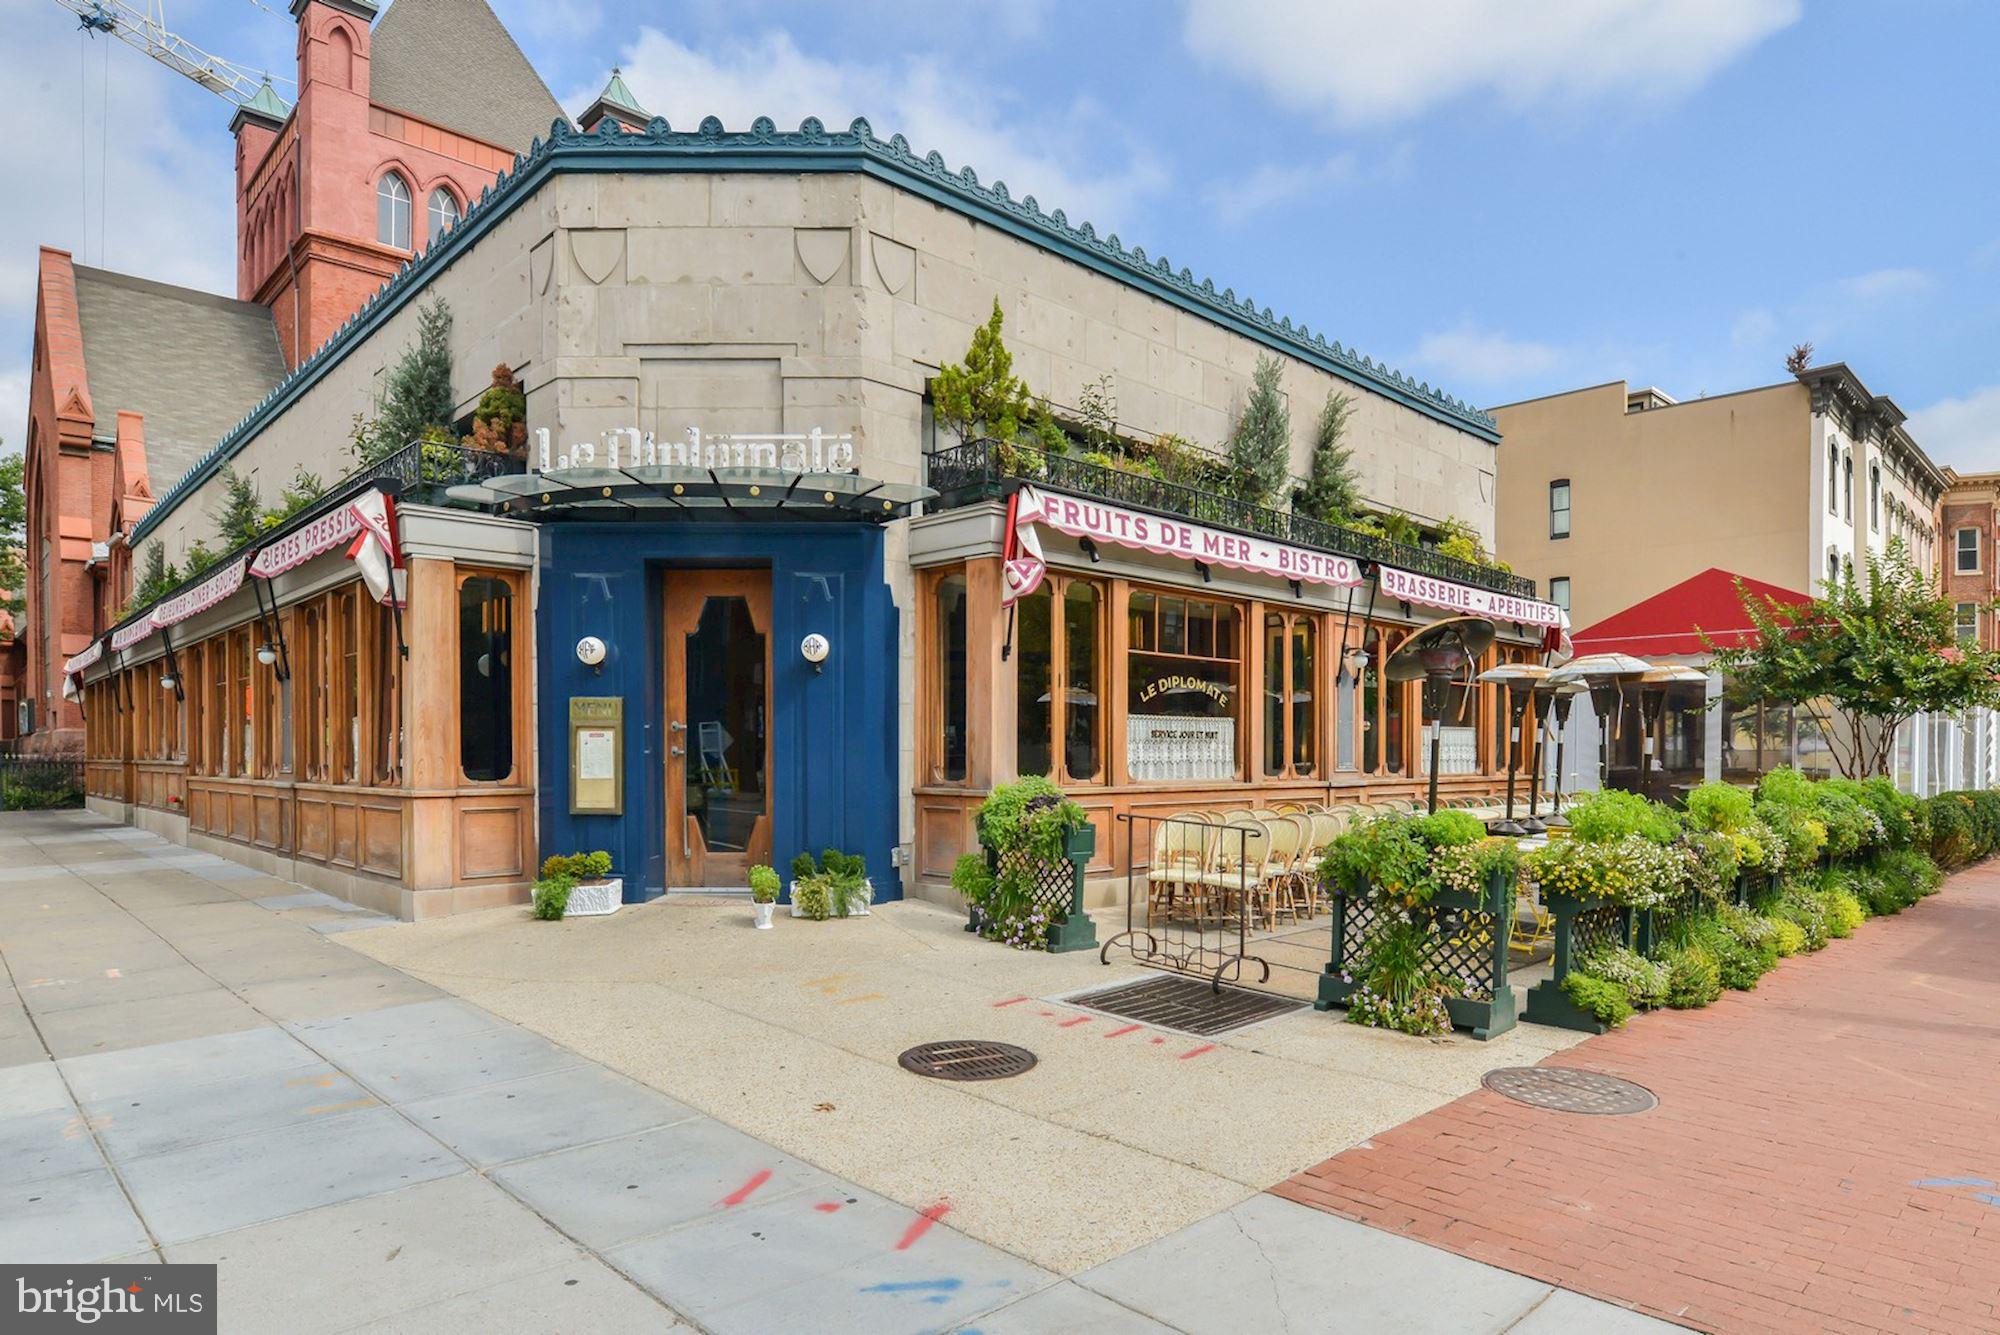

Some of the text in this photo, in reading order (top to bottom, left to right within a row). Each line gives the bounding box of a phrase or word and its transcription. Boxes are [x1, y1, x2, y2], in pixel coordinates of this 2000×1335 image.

[535, 427, 595, 473] Le
[305, 507, 358, 549] PRESSIO
[1042, 495, 1149, 541] FRUITS
[1160, 522, 1193, 550] DE
[1203, 532, 1251, 562] MER
[1278, 548, 1350, 580] BISTRO
[1386, 571, 1471, 606] BRASSERIE
[1140, 675, 1229, 708] LE DIPLOMATE
[1151, 730, 1177, 739] SERVICE
[1179, 730, 1194, 739] JOUR
[1196, 731, 1204, 739] ET
